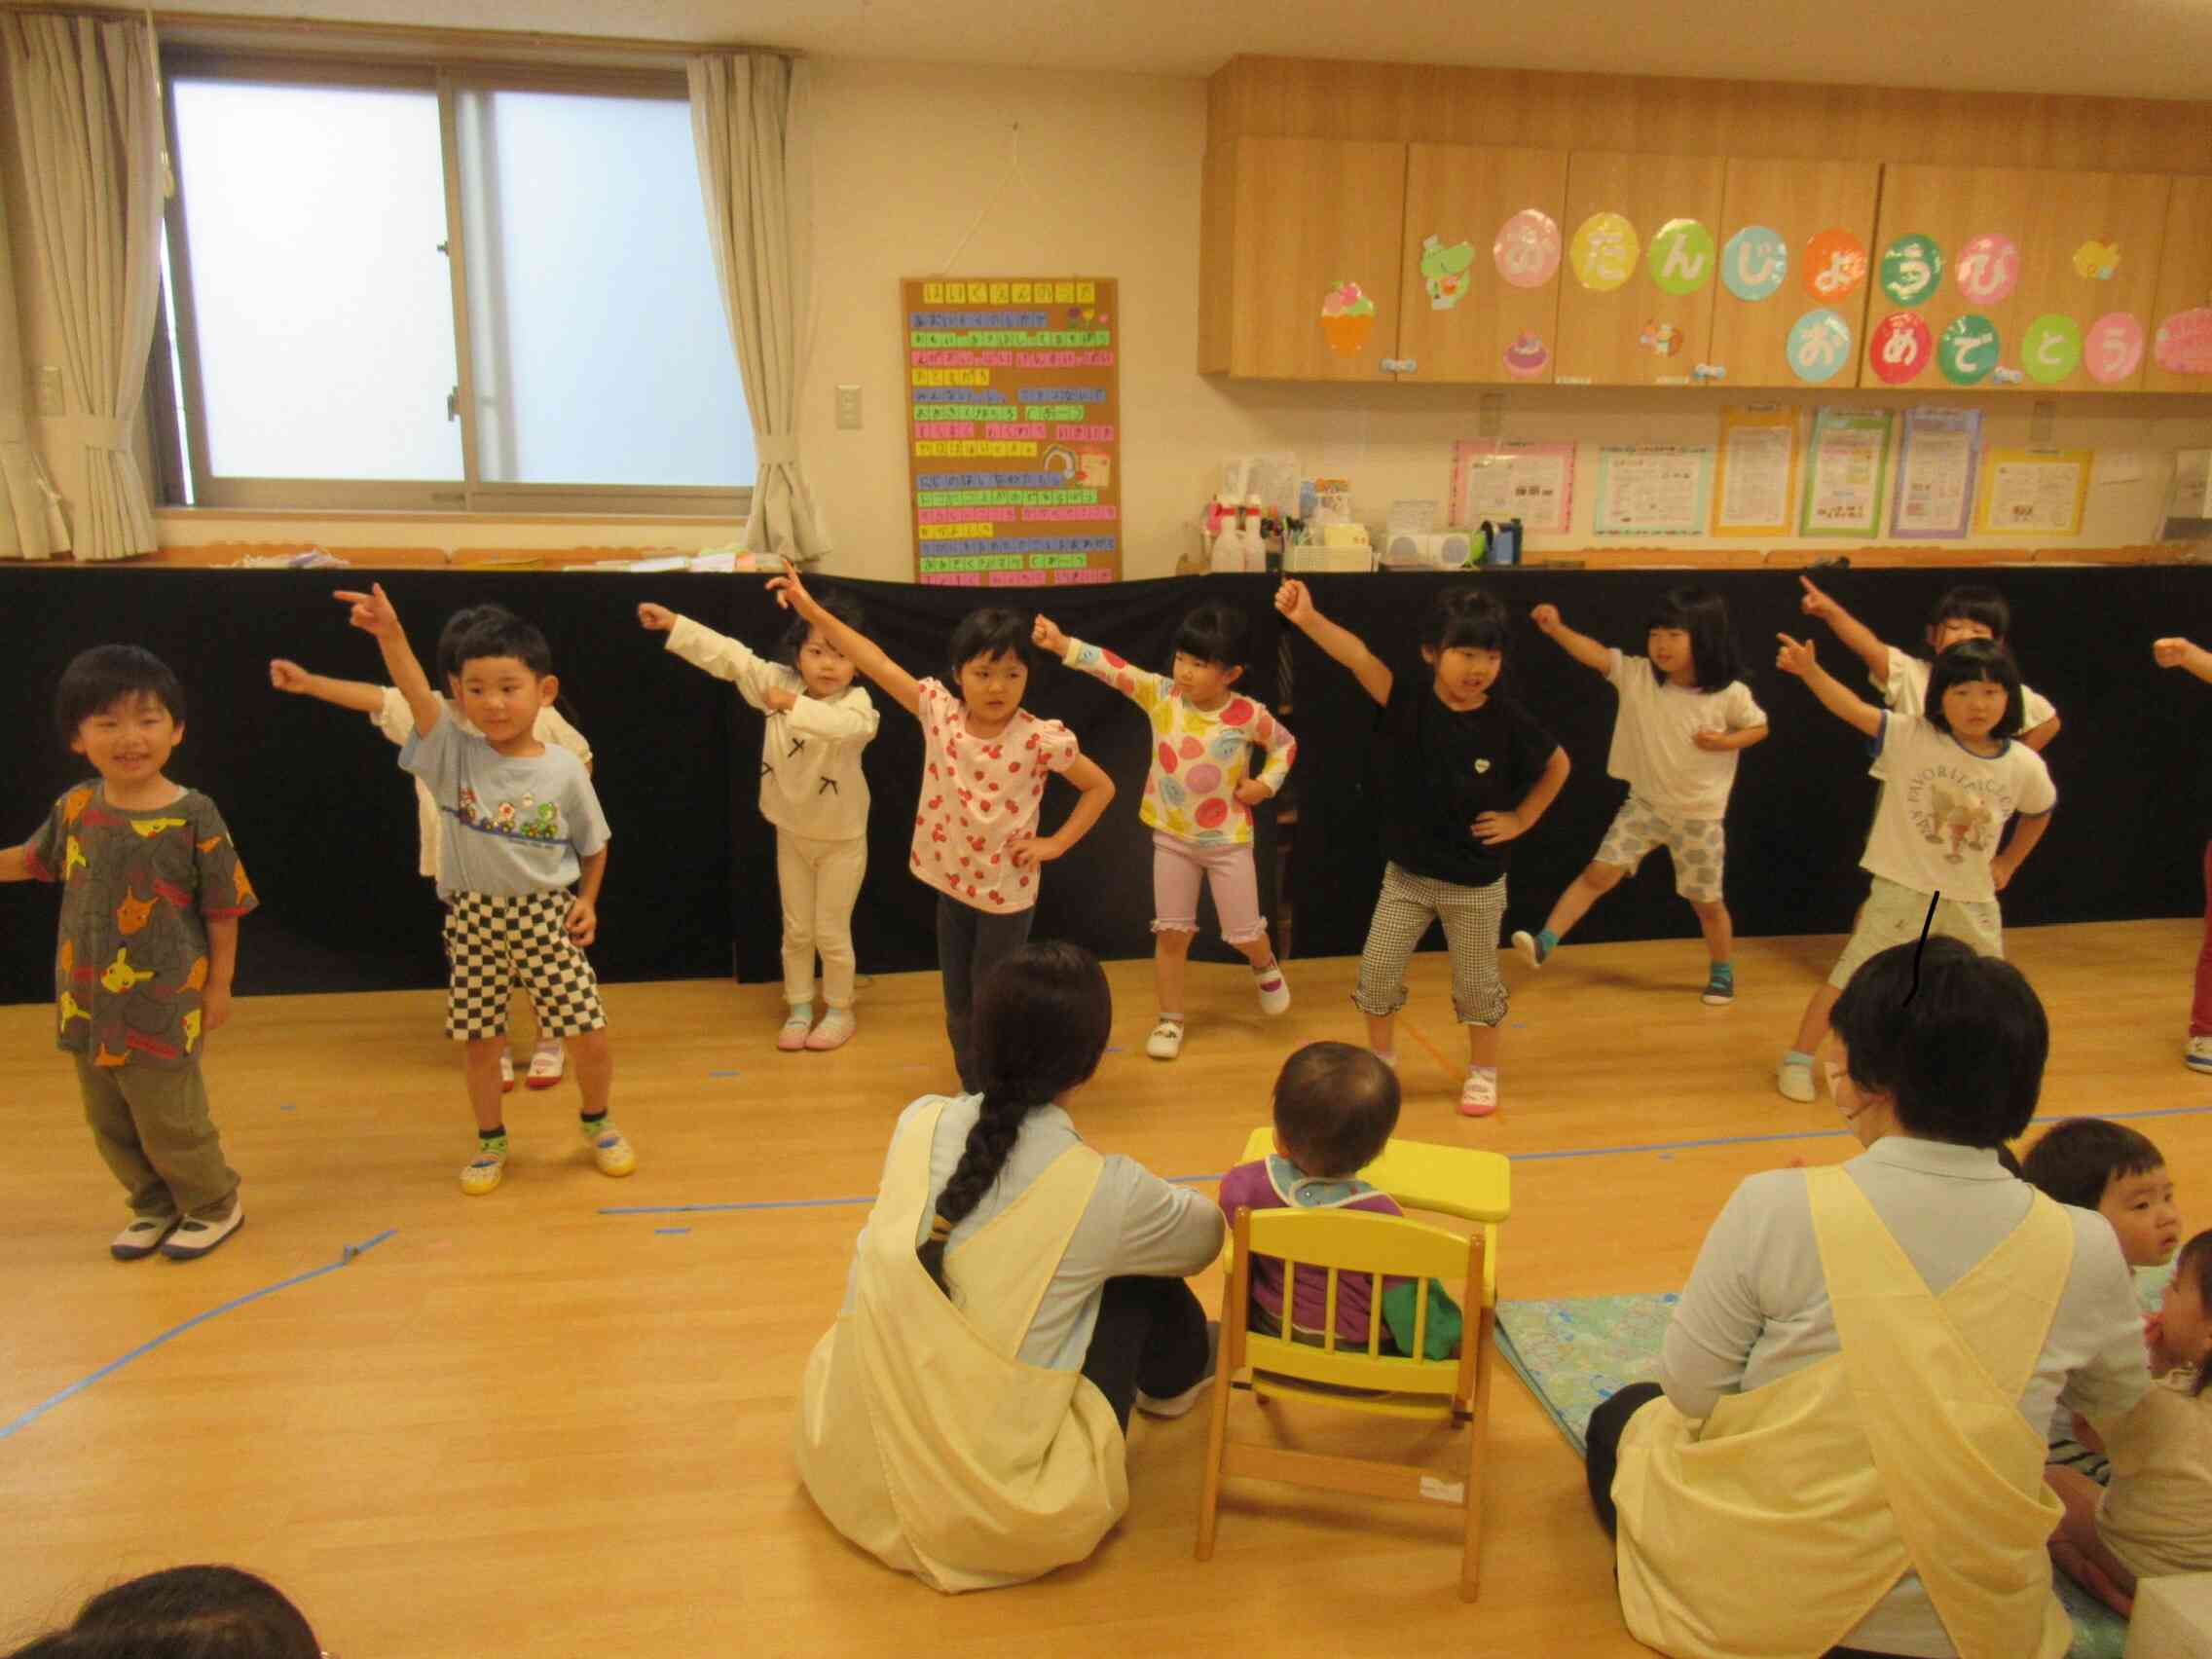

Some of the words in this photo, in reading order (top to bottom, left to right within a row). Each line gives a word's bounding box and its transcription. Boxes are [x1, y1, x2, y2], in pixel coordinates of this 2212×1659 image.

[1797, 323, 2129, 376] おめでとう
